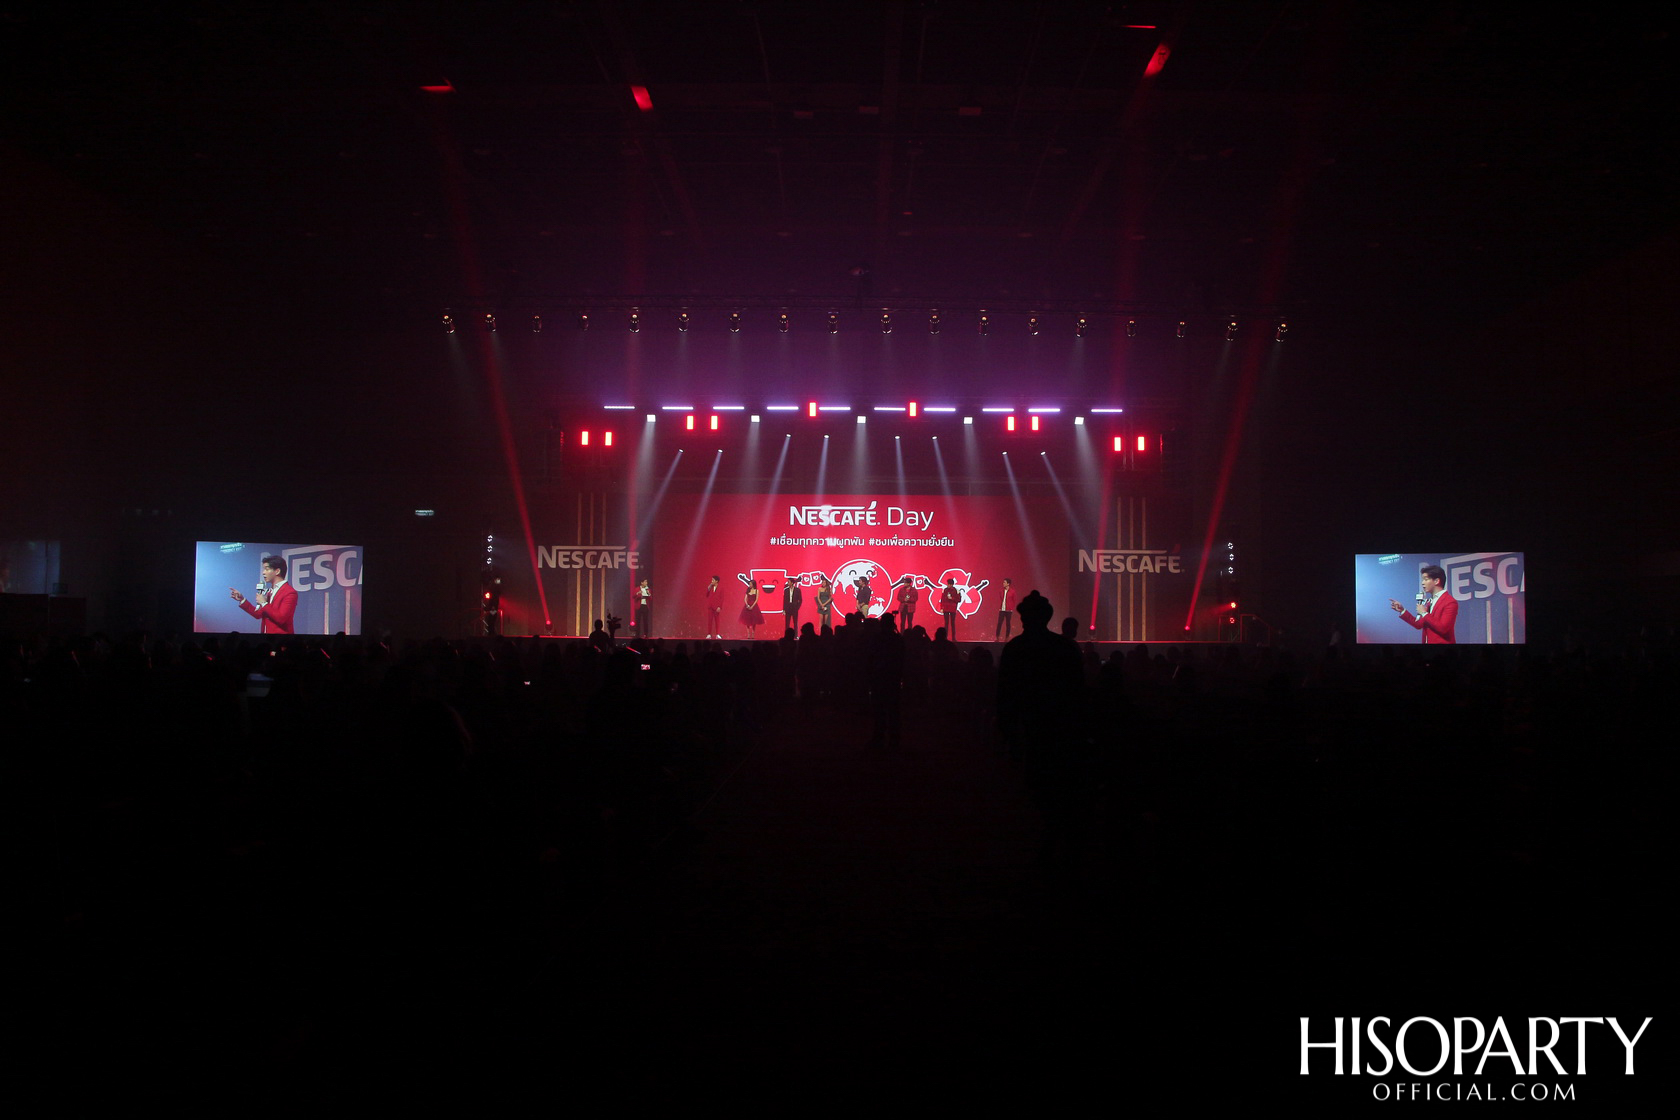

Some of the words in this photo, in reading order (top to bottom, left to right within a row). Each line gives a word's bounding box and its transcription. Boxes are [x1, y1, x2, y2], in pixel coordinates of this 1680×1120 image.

[887, 506, 935, 531] Day
[868, 534, 955, 547] #ชงเพื่อความยั่งยืน
